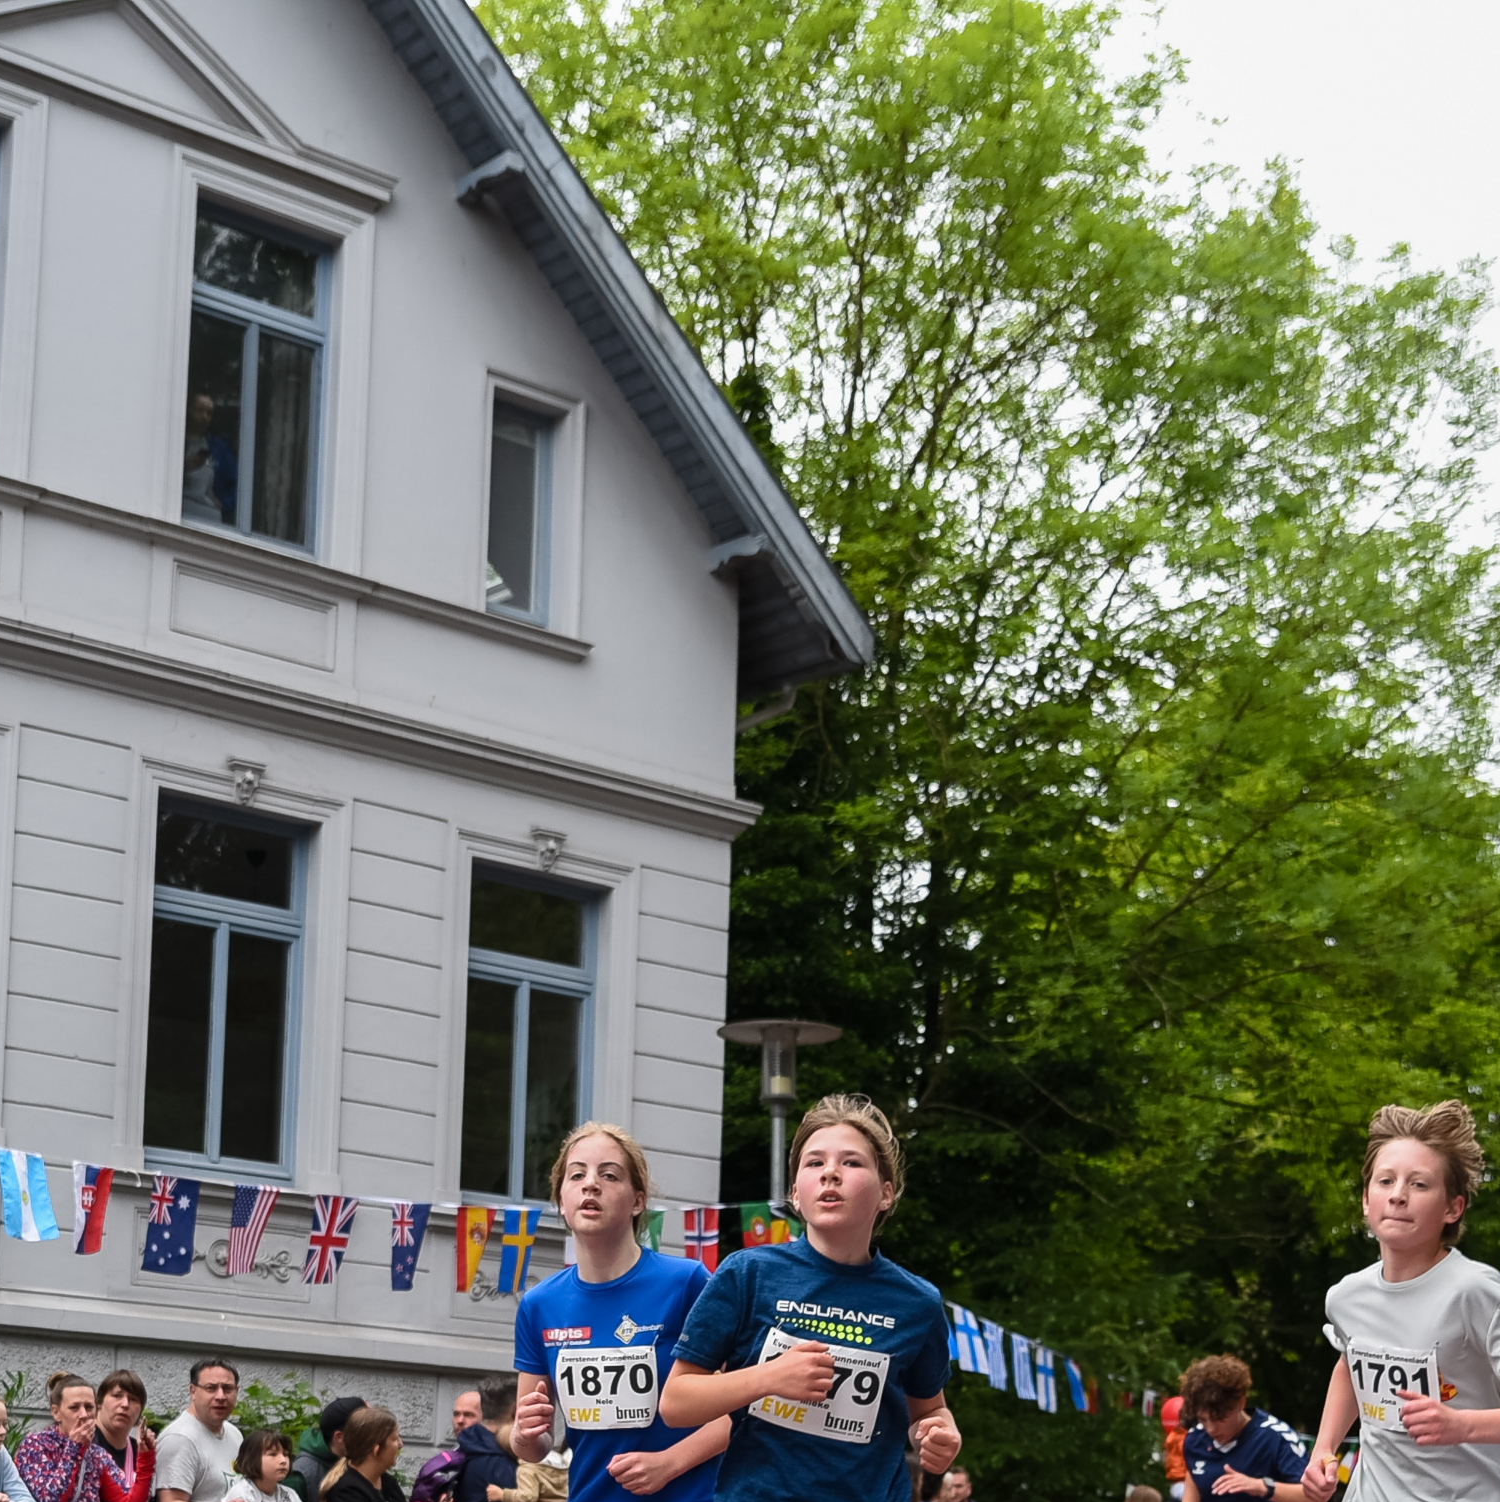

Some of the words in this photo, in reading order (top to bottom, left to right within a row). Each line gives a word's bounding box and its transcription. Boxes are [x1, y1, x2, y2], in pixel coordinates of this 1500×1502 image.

[776, 1299, 896, 1330] ENDURANCE
[546, 1327, 584, 1341] ulpts
[601, 1353, 649, 1362] Brunnenlauf
[825, 1351, 881, 1369] runnenlauf
[1351, 1348, 1383, 1360] Everstener
[1385, 1353, 1429, 1364] Brunnenlauf
[560, 1363, 654, 1397] 1870
[1352, 1359, 1430, 1397] 1791
[569, 1408, 601, 1422] EWE
[616, 1406, 650, 1420] bruns
[761, 1397, 808, 1424] EWE
[1361, 1402, 1386, 1421] EWE
[824, 1411, 865, 1433] bruns
